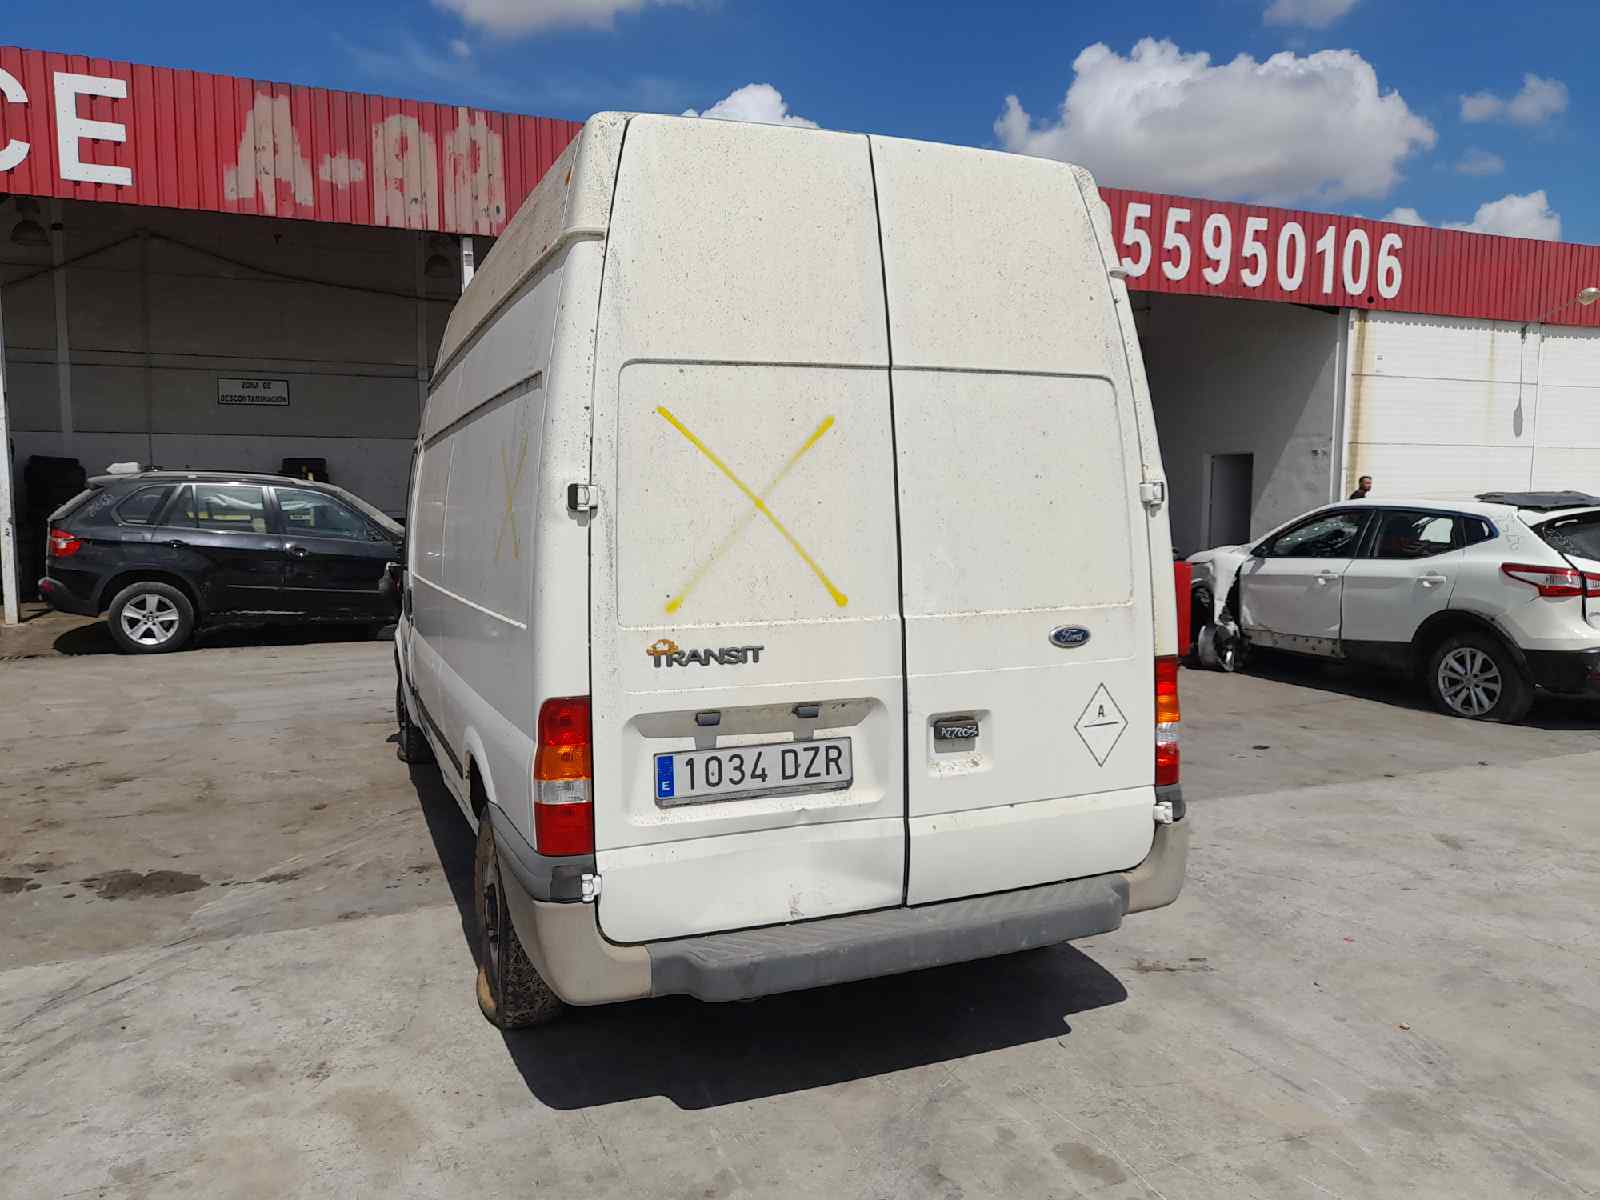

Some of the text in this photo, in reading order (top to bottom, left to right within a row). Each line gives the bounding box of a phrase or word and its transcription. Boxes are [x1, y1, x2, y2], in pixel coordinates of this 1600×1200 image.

[1120, 202, 1403, 299] 55950106
[1097, 704, 1105, 718] A
[662, 745, 843, 790] E 1034 DZR
